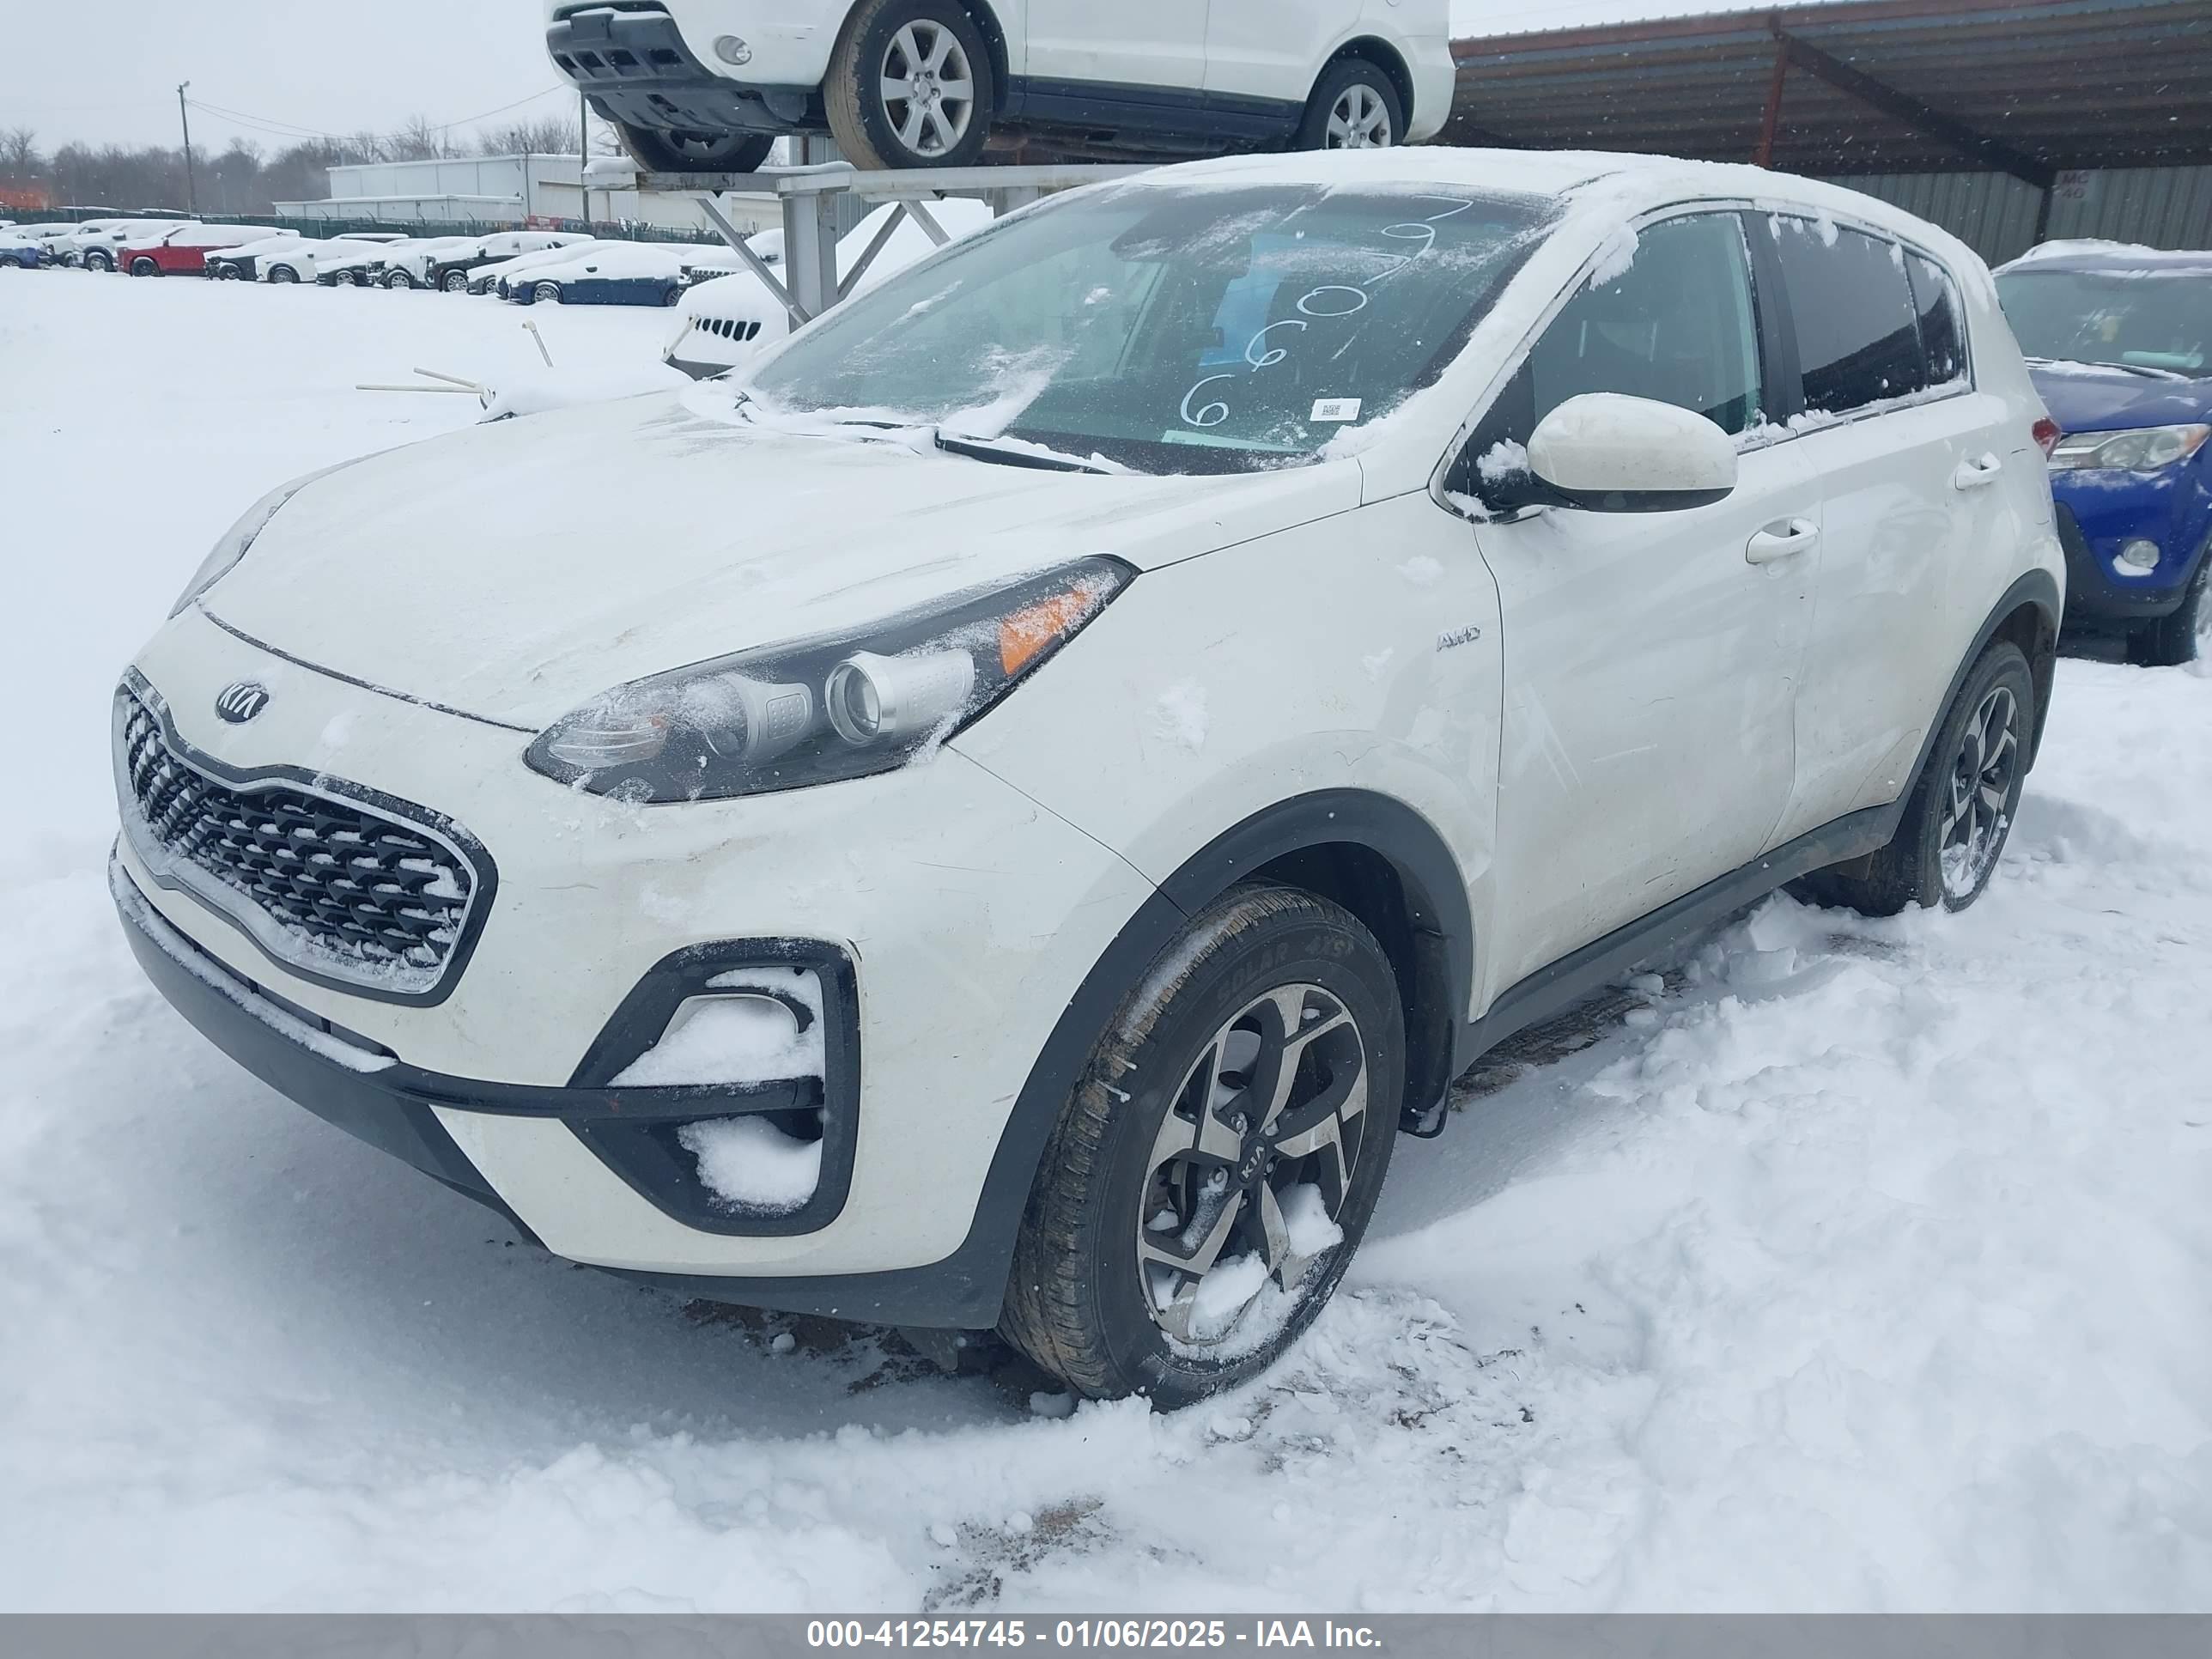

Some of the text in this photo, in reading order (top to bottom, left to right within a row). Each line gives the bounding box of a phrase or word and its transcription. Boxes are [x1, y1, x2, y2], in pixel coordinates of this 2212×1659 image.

[2062, 171, 2089, 185] MC
[1436, 626, 1480, 653] AWD
[218, 683, 262, 719] KIA
[1242, 1146, 1264, 1179] KIA
